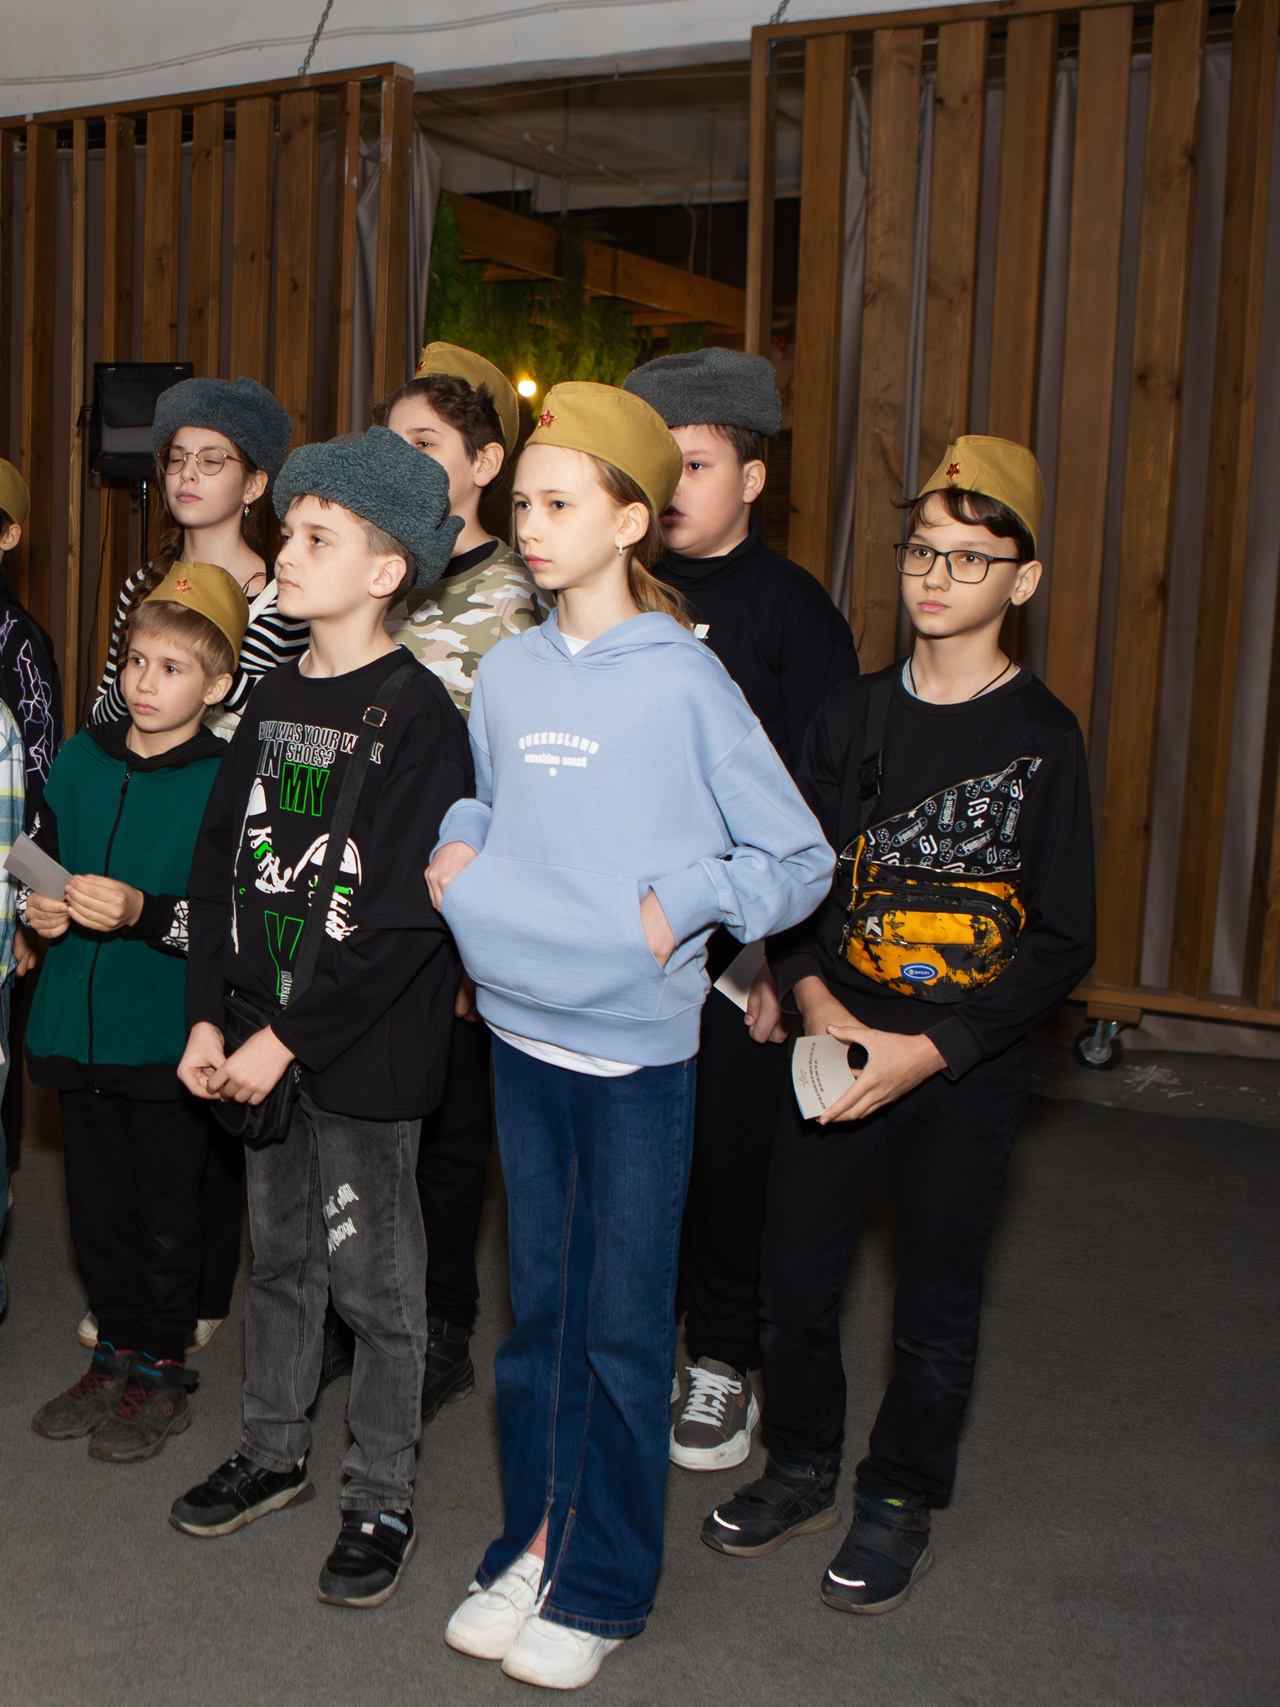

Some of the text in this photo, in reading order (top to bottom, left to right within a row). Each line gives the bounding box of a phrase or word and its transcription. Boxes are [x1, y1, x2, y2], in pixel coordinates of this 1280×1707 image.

[275, 720, 303, 744] WAS
[304, 724, 342, 751] YOUR
[518, 731, 600, 755] QUEENSLAND
[285, 741, 336, 769] SHOES?
[279, 761, 331, 817] MY
